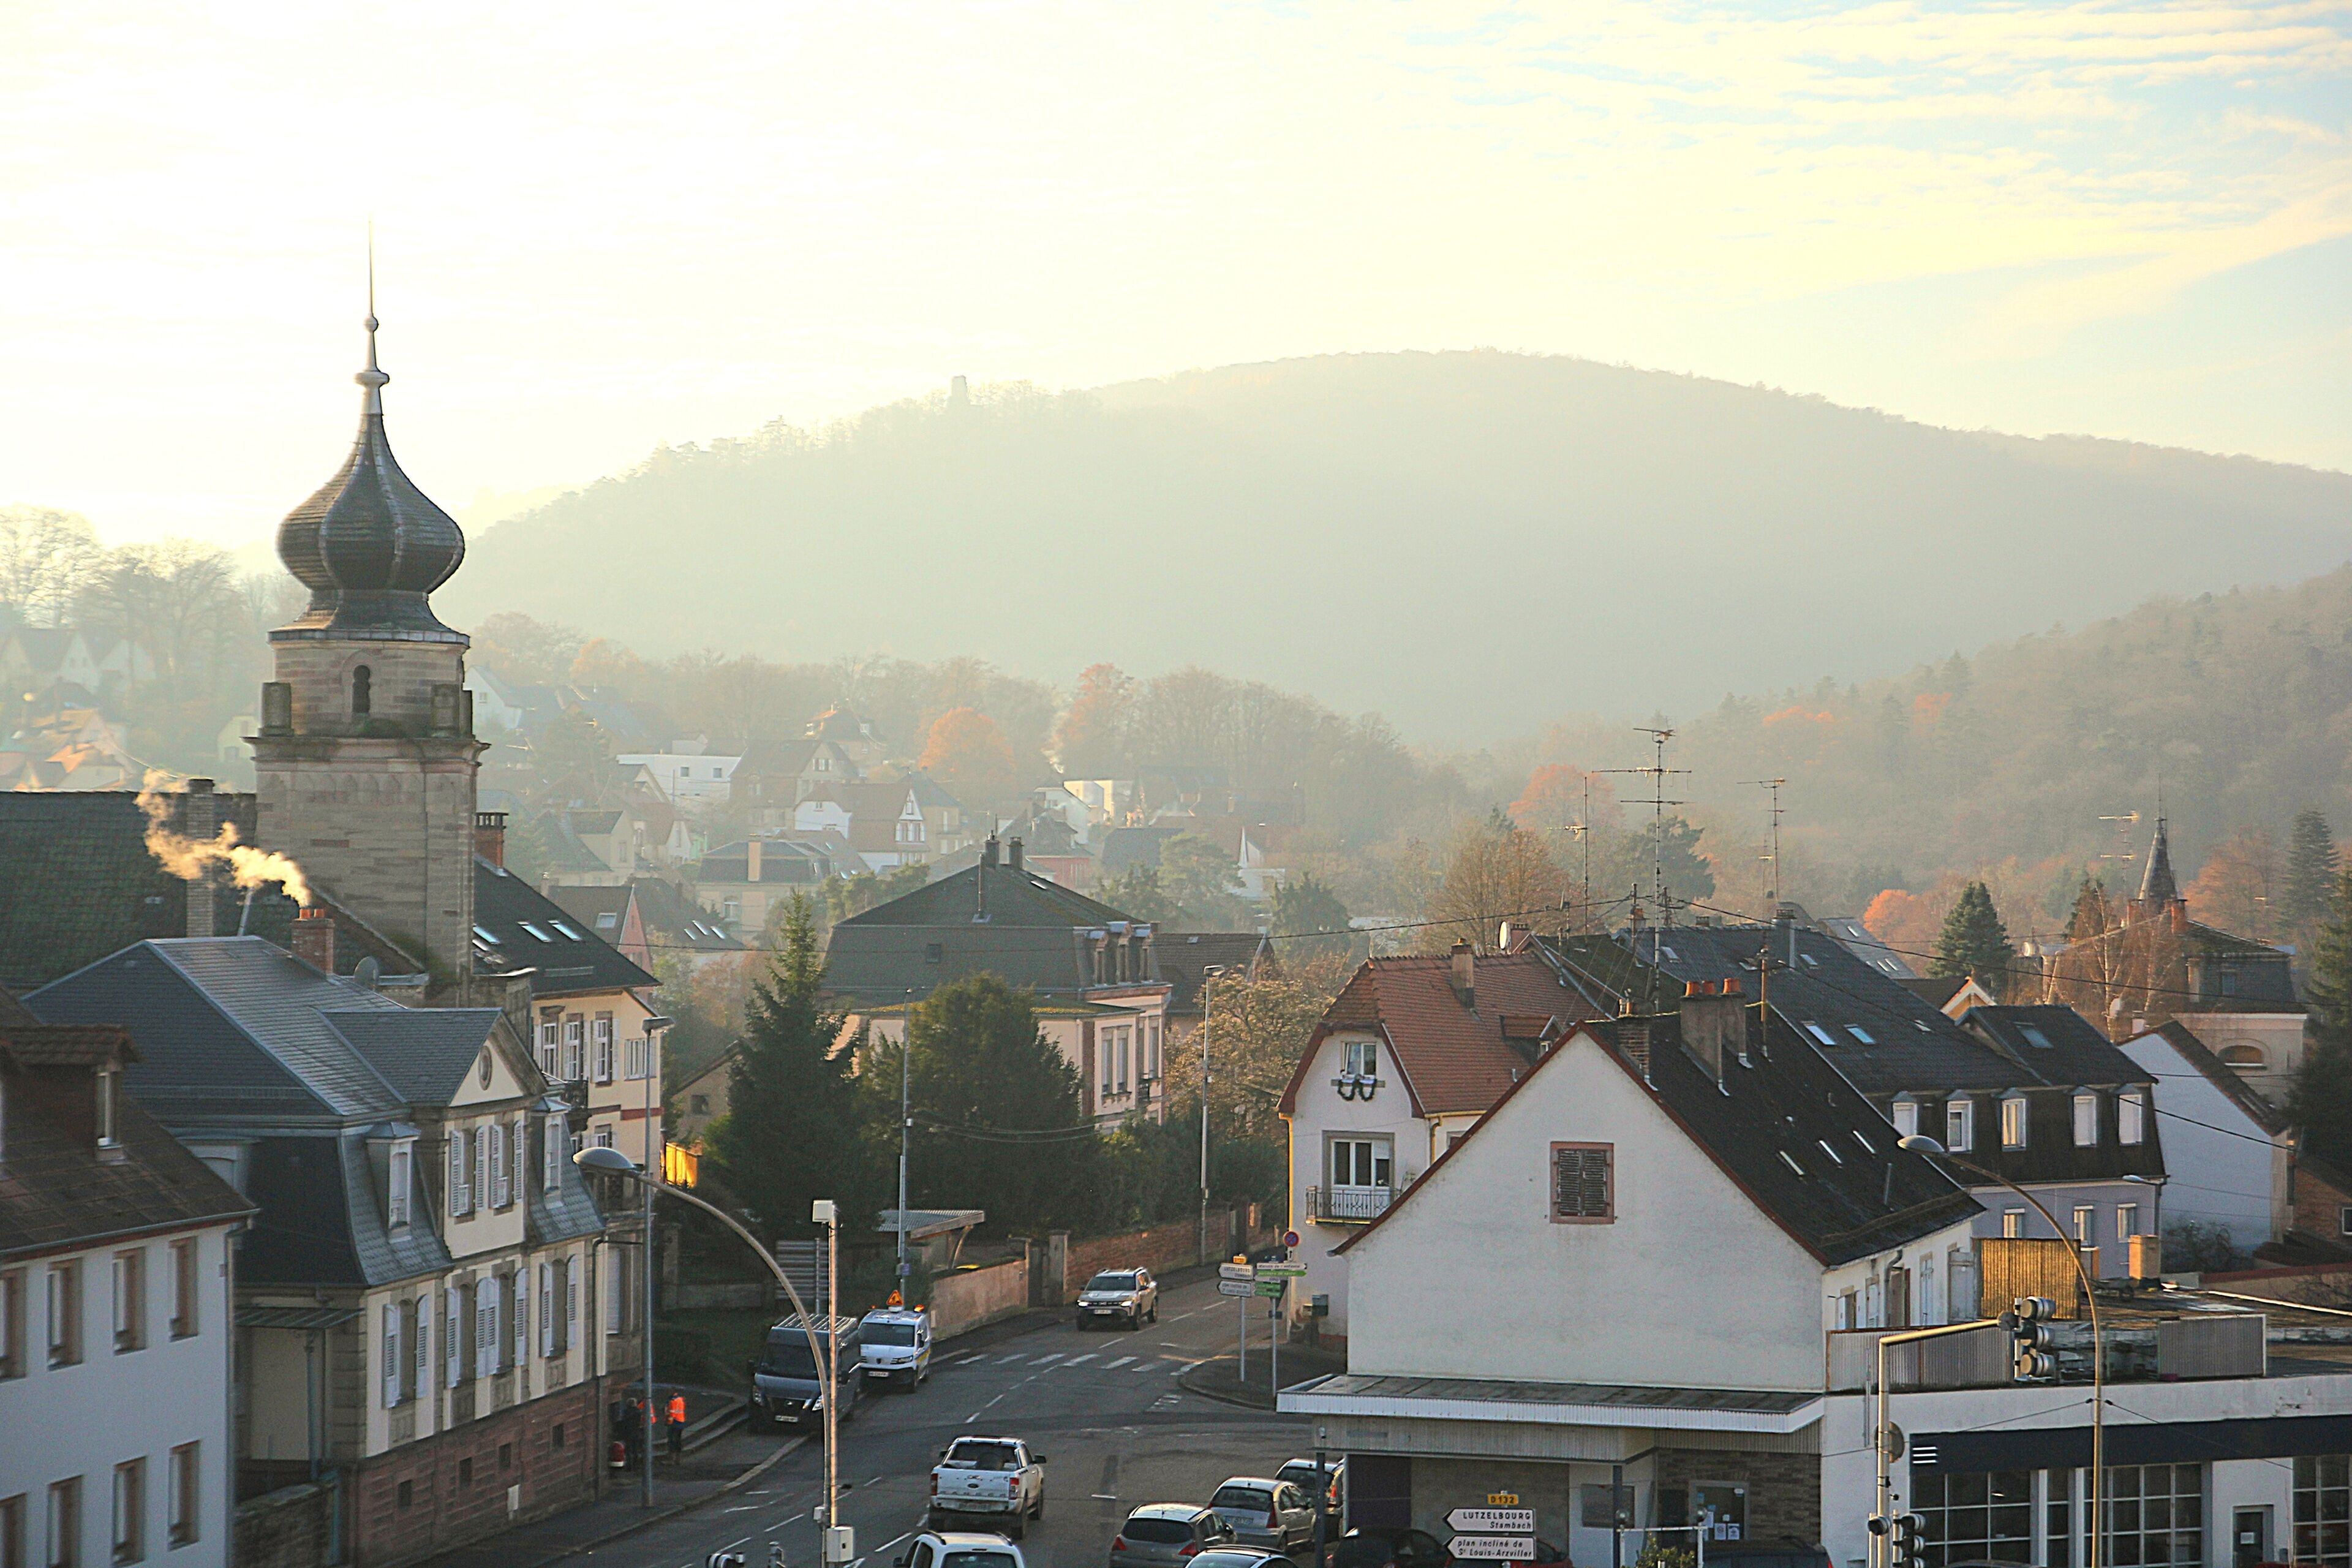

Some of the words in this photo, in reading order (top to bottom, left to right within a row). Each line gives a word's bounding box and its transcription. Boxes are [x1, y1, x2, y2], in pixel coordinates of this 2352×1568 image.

[1457, 1539, 1476, 1548] plan
[1479, 1539, 1509, 1548] incliné
[1470, 1548, 1532, 1557] Louis-Arzviller
